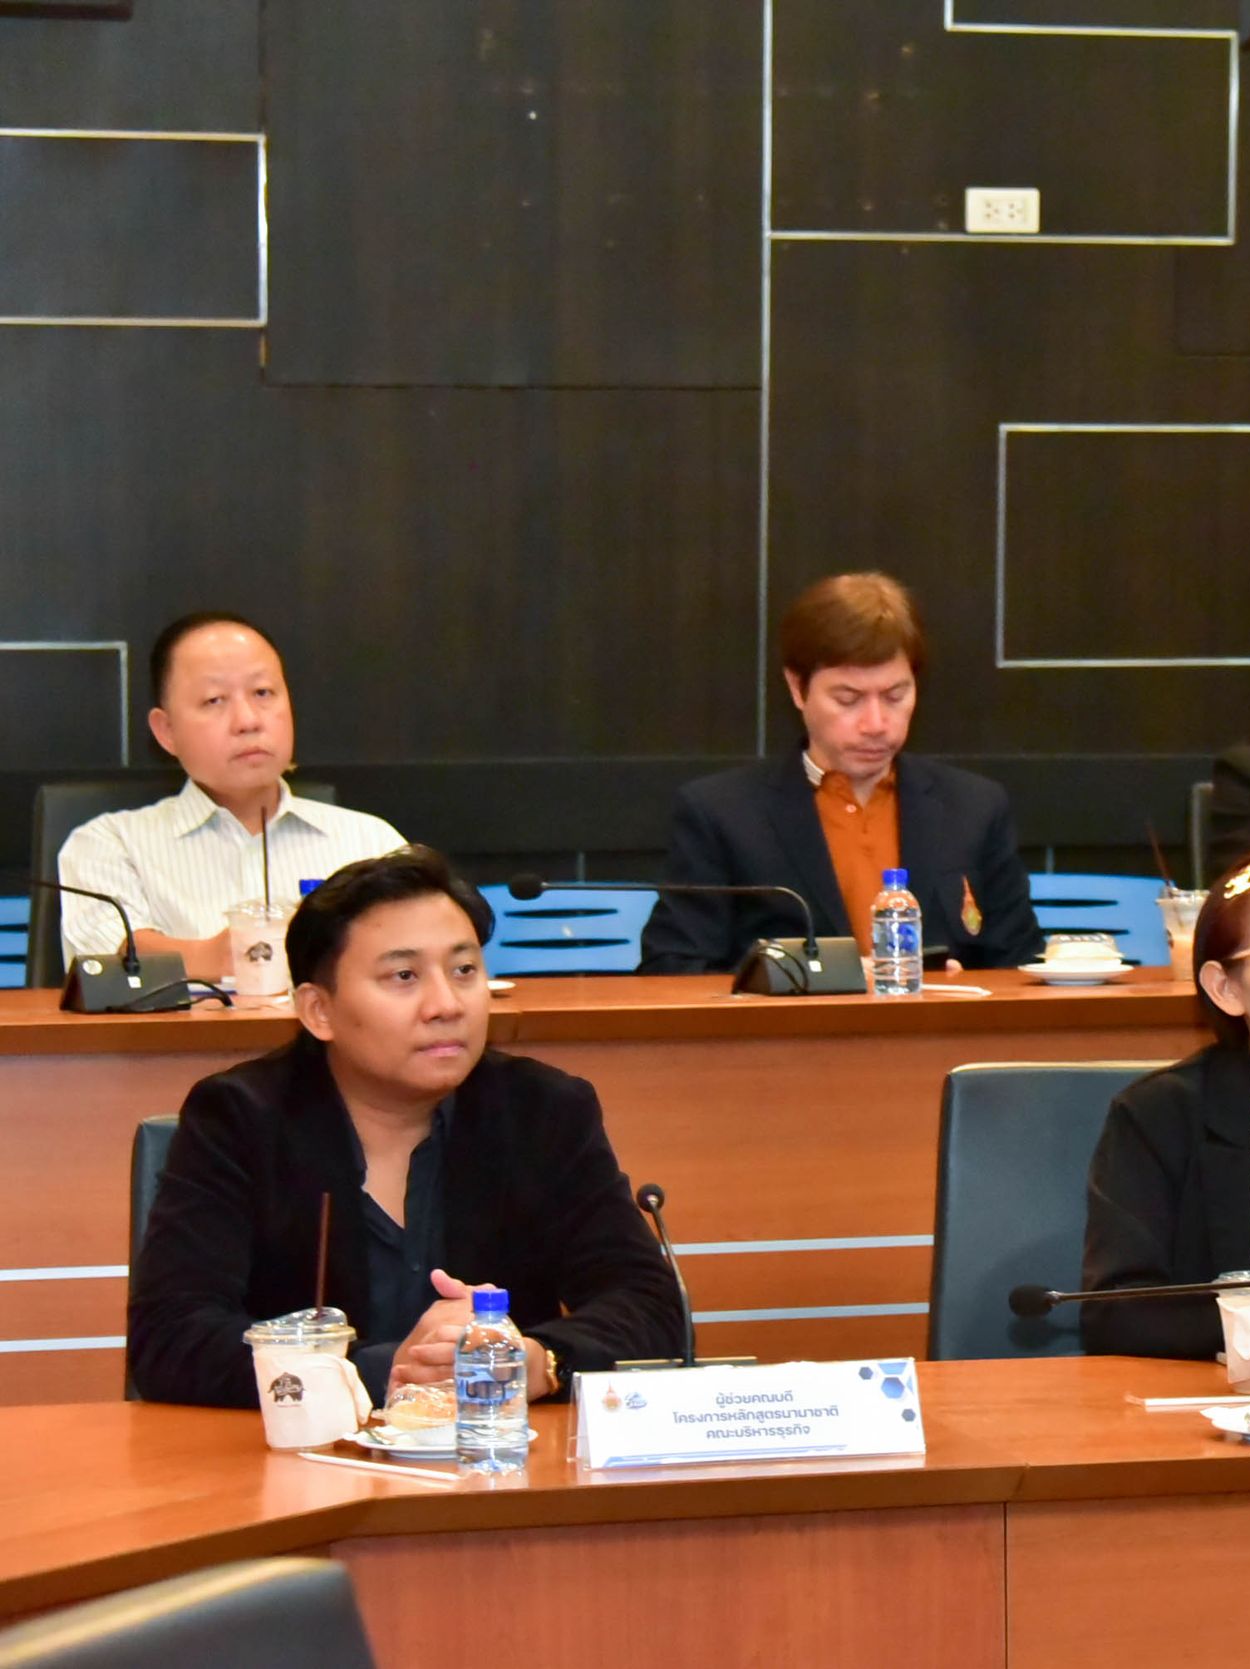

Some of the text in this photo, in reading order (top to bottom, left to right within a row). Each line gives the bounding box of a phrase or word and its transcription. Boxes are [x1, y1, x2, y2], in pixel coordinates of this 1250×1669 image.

[715, 1390, 794, 1408] ผู้ช่วยคณบดี
[672, 1404, 839, 1424] โครงการหลักสูตรนานาชาติ
[706, 1424, 811, 1440] คณะบริหารธุรกิจ
